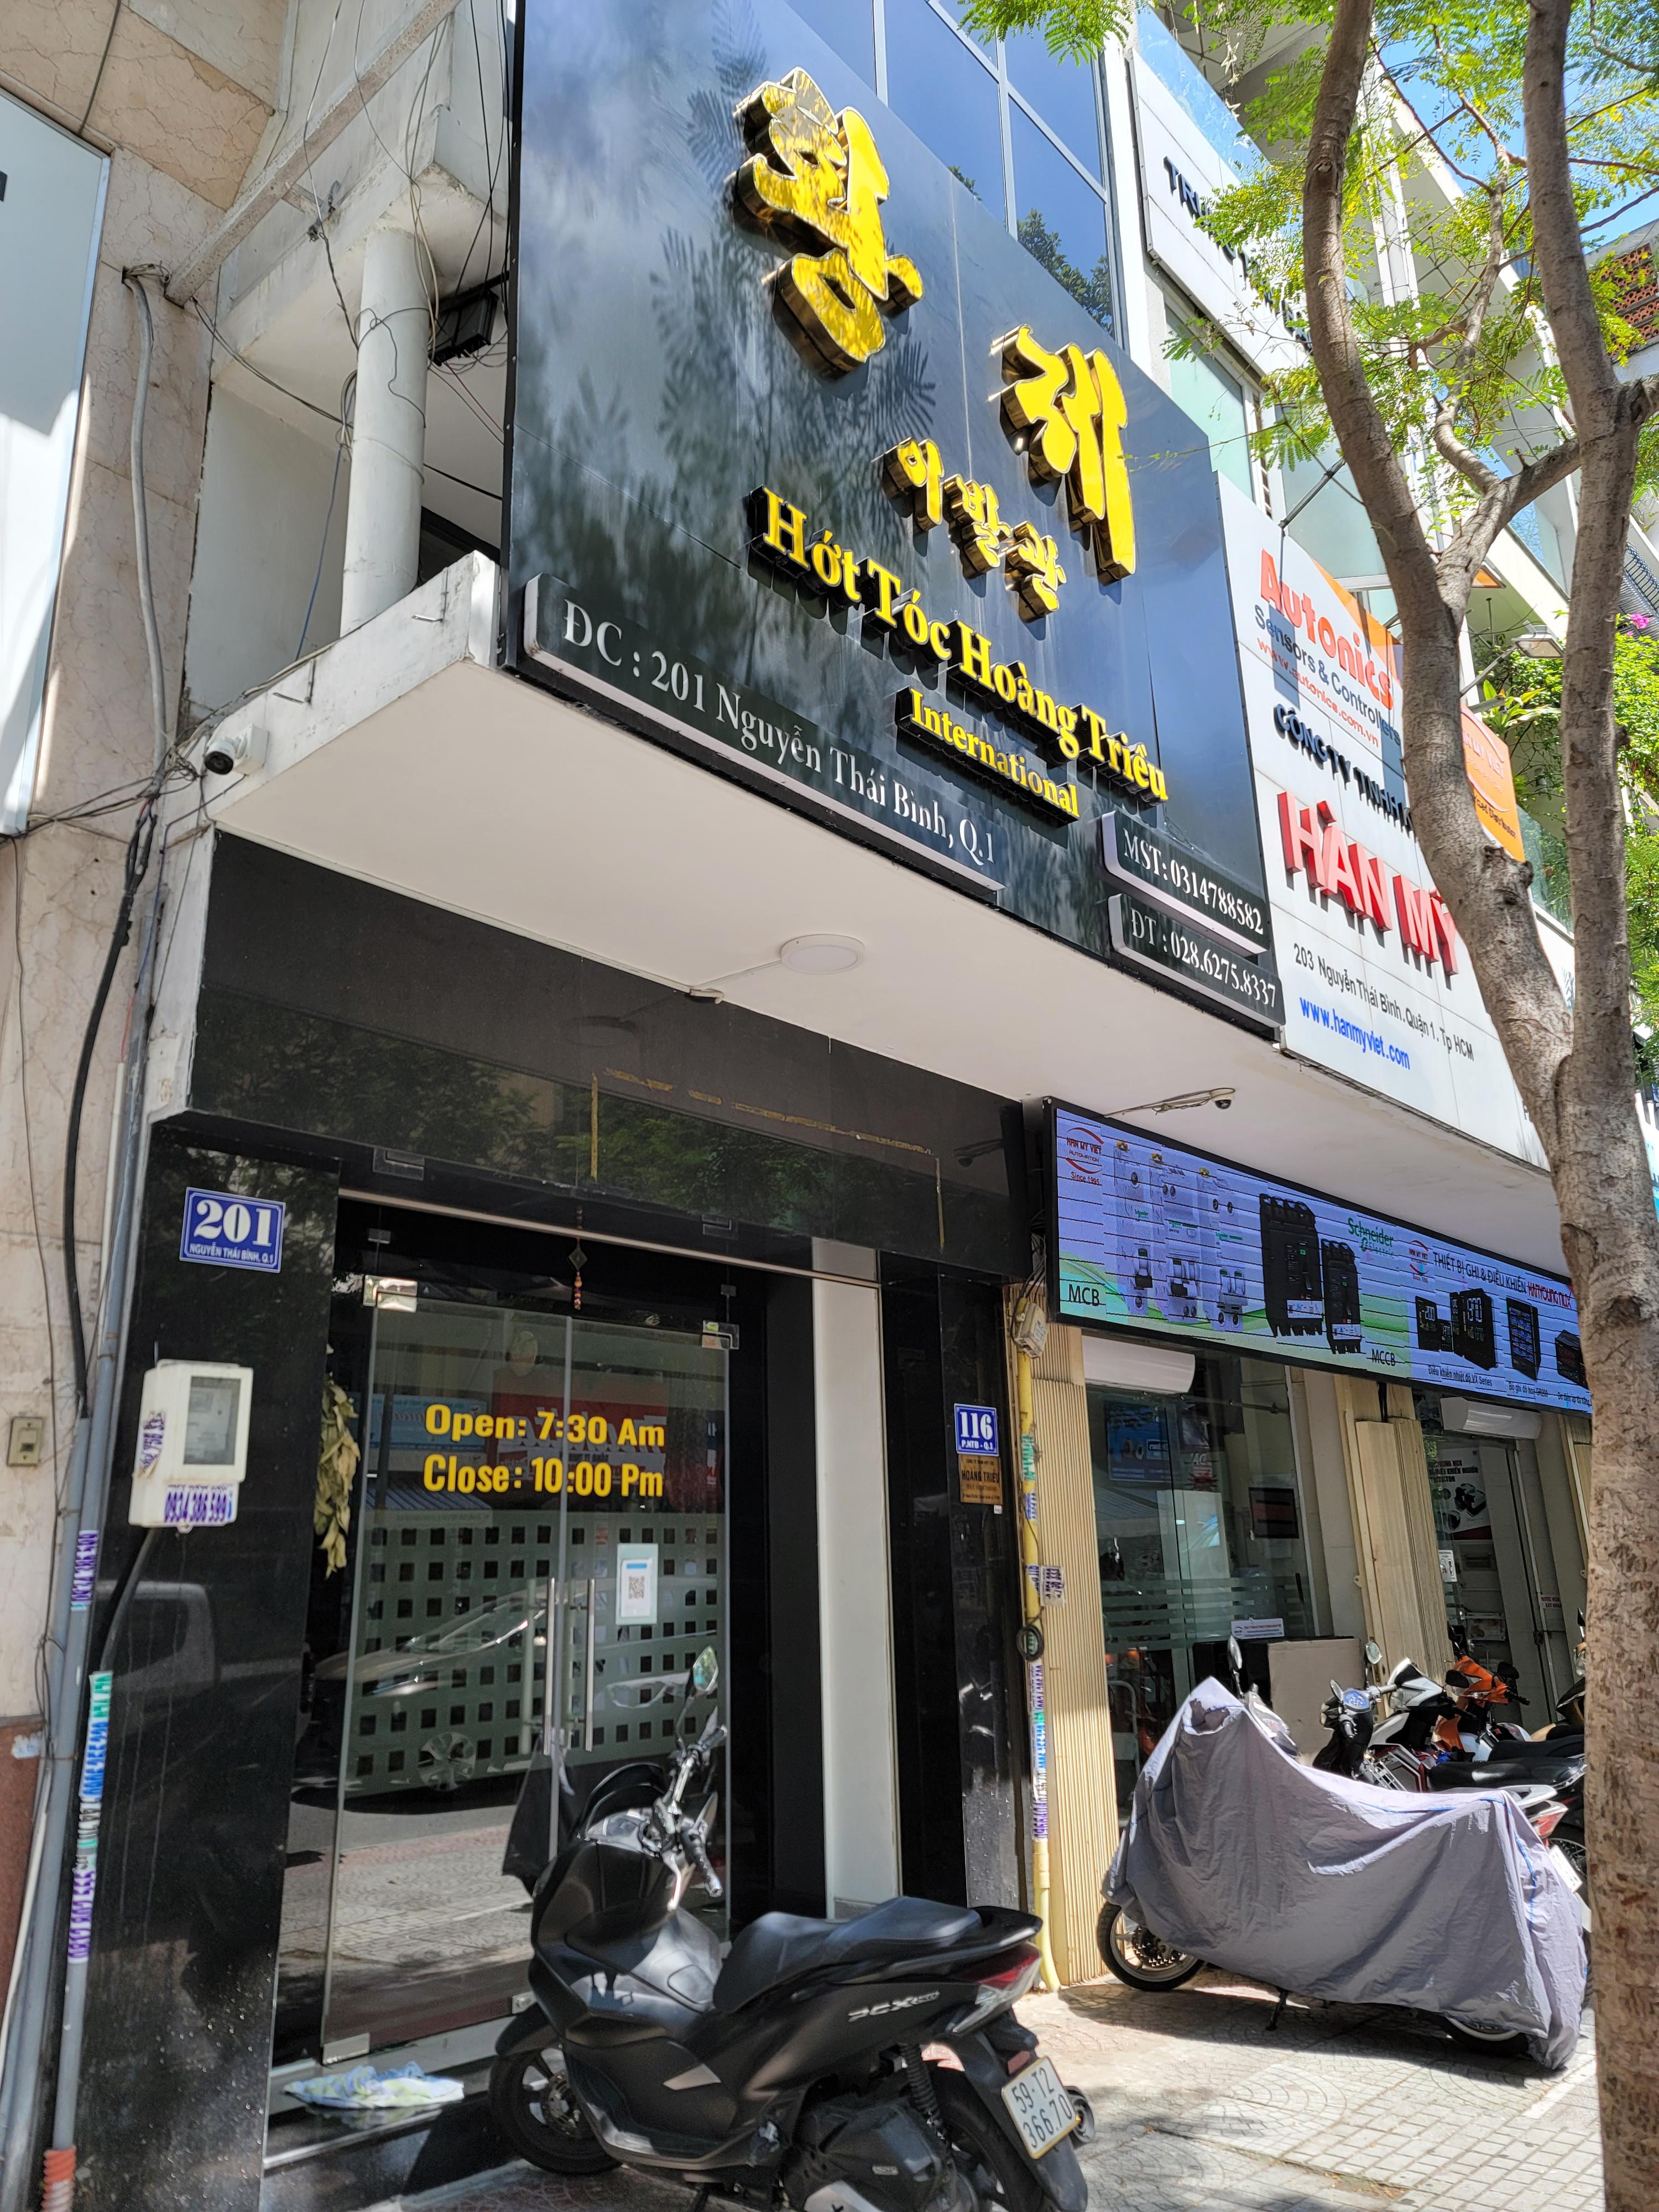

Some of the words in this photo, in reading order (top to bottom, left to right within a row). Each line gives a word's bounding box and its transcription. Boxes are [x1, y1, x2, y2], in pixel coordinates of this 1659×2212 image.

[763, 487, 860, 602] Hớt
[868, 558, 951, 659] Tóc
[957, 622, 1081, 759] Hoàng
[1082, 704, 1168, 801] Triều
[1261, 549, 1394, 710] Autonics
[1255, 605, 1315, 671] Sensors
[1318, 656, 1329, 685] &
[1332, 676, 1401, 746] Controllers
[1257, 637, 1379, 748] www.autonics.com.vn
[651, 650, 705, 712] 201
[716, 682, 821, 774] Nguyễn
[830, 745, 886, 807] Thái
[959, 818, 995, 865] Q.1
[910, 688, 1080, 817] International
[1274, 703, 1328, 761] CÔNG
[1327, 745, 1351, 784] TY
[1277, 791, 1392, 932] HÀN
[1171, 859, 1264, 935] 0314788582
[1171, 931, 1276, 1008] 028.6275.8337
[1293, 943, 1314, 971] 203
[1318, 956, 1356, 995] Nguyễn
[1356, 978, 1378, 1008] Thái
[1453, 1034, 1474, 1061] HCM
[1071, 1171, 1086, 1181] Since
[194, 1199, 272, 1247] 201
[1348, 1218, 1394, 1248] Schneider
[190, 1241, 221, 1257] NGUYỄN
[223, 1246, 241, 1260] THÁI
[262, 1253, 274, 1264] Q.1
[1369, 1242, 1394, 1259] Electric
[1433, 1252, 1455, 1271] THIẾT
[1466, 1264, 1479, 1277] GHI
[1481, 1269, 1486, 1281] &
[1069, 1284, 1100, 1306] MCB
[1371, 1348, 1396, 1366] MCCB
[1479, 1376, 1493, 1386] Series
[425, 1404, 526, 1442] Open:
[536, 1411, 607, 1445] 7:30
[617, 1418, 665, 1447] Am
[960, 1412, 993, 1440] 116
[531, 1457, 611, 1497] 10:00
[621, 1463, 663, 1498] Pm
[1024, 2094, 1072, 2148] 366.70
